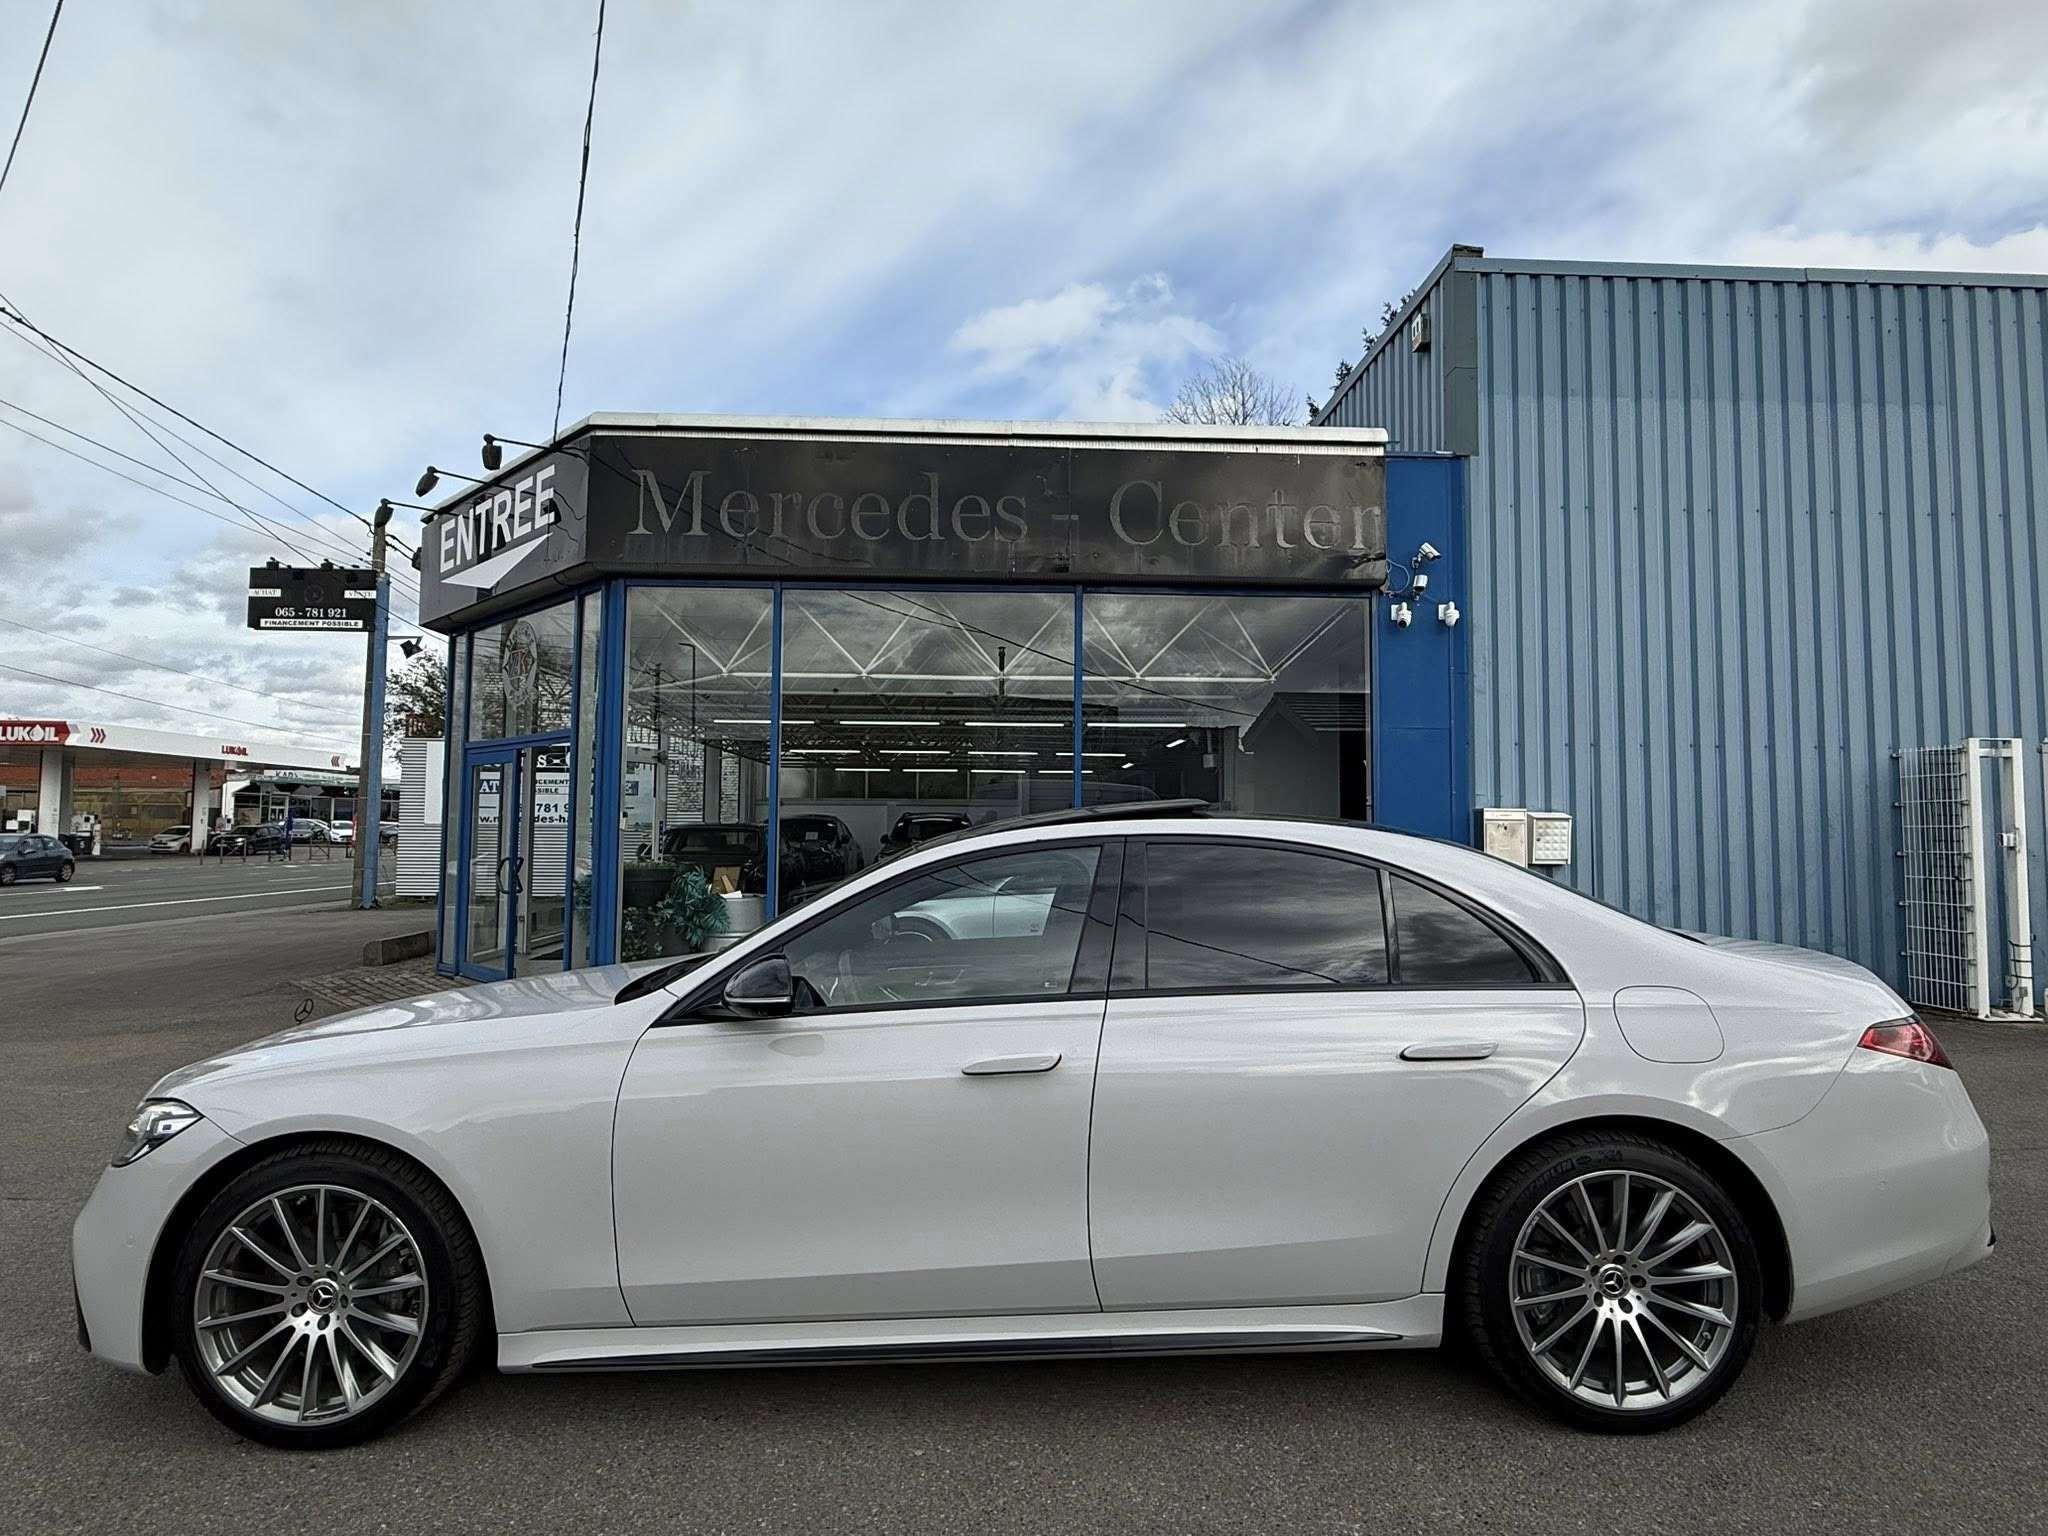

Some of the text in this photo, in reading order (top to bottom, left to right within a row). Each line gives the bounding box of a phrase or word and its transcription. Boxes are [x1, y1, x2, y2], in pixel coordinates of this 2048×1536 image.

[626, 468, 1030, 544] Mercedes
[1109, 479, 1383, 550] Center
[439, 463, 556, 574] ENTREE
[274, 606, 295, 617] 065
[305, 607, 324, 618] 781
[327, 608, 347, 618] 921
[0, 724, 60, 742] LUKOIL
[221, 744, 248, 756] LUKOIL
[536, 803, 558, 813] 781
